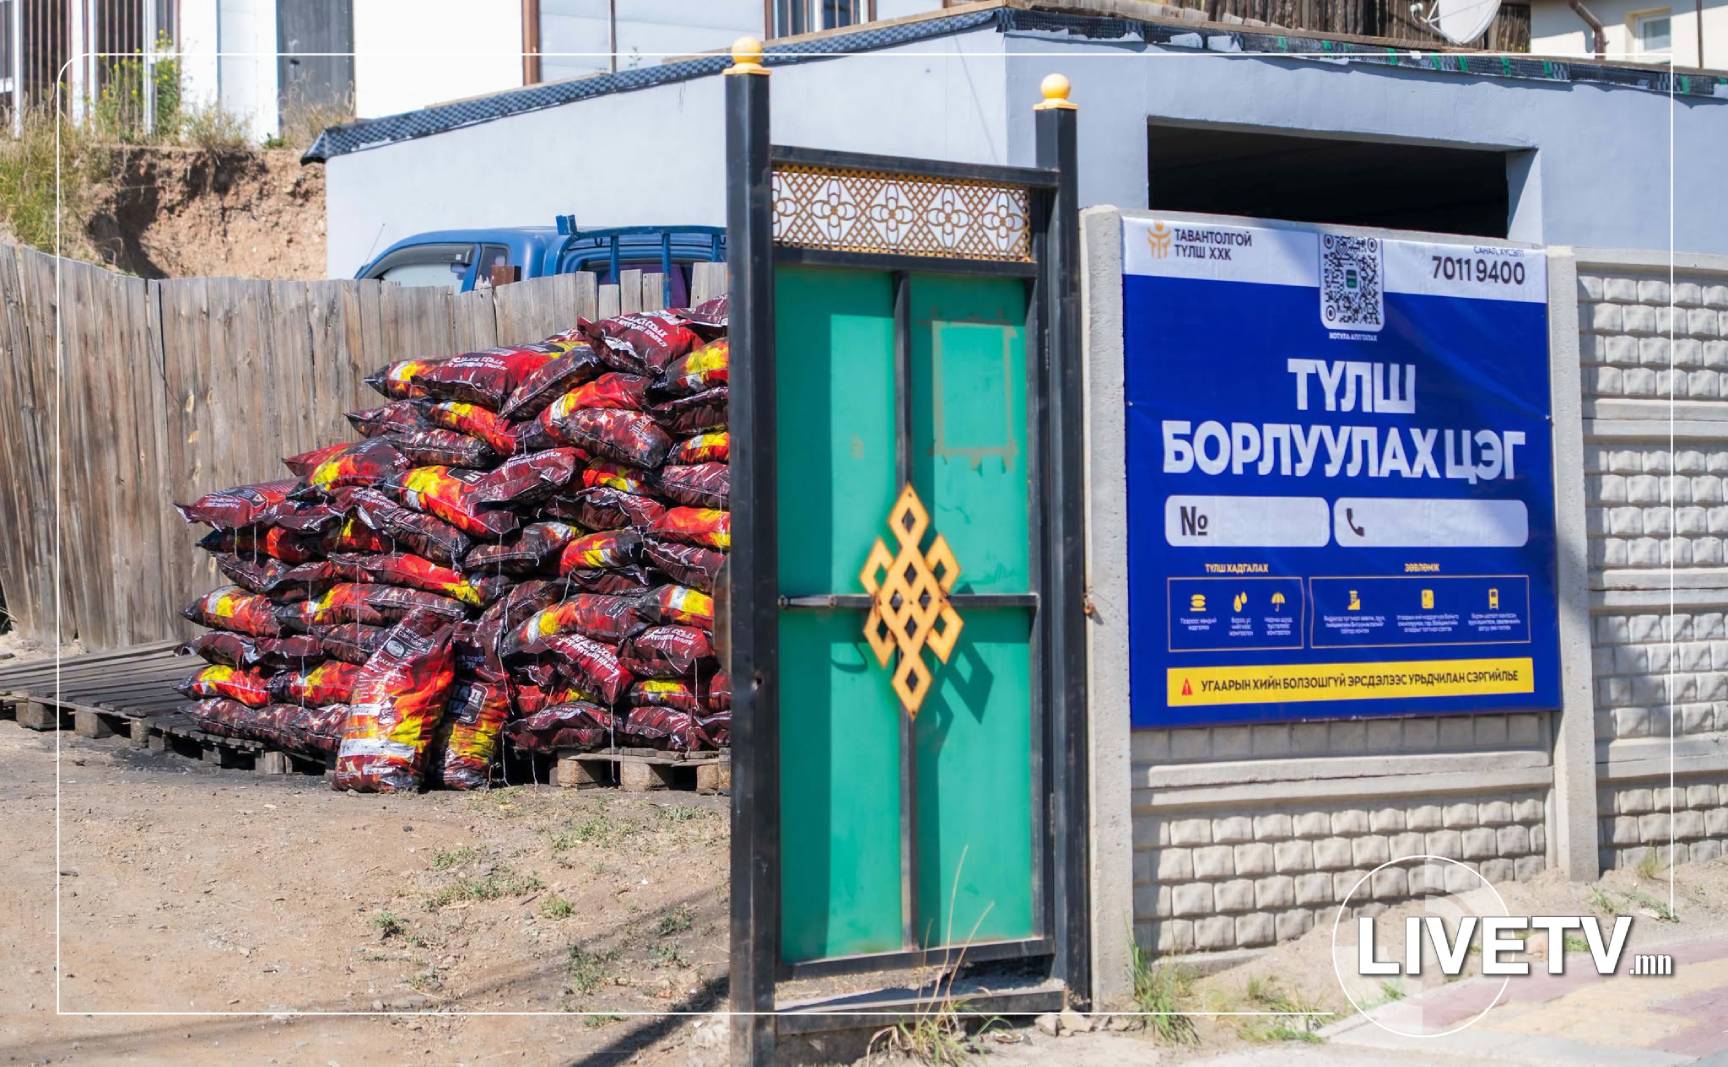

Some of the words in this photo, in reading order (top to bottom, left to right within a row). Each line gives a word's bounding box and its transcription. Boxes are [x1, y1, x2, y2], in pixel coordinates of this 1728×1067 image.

[1174, 228, 1252, 247] ТАВАНТОЛГОЙ
[1174, 244, 1206, 258] ТҮЛШ
[1209, 246, 1232, 260] ХХК
[1287, 358, 1416, 414] ТҮЛШ
[1161, 419, 1441, 479] БОРЛУУЛАХ
[1444, 429, 1526, 485] ЦЭГ
[1226, 563, 1269, 574] ХАДГАЛАХ
[1201, 679, 1250, 692] УГААРЫН
[1252, 675, 1281, 690] ХИЙН
[1283, 673, 1346, 689] БОЛЗОШГҮЙ
[1347, 674, 1407, 689] ЭРСДЭЛЭЭС
[1408, 672, 1466, 687] УРЬДЧИЛАН
[1466, 668, 1518, 682] СЭРГИЙЛЬЕ
